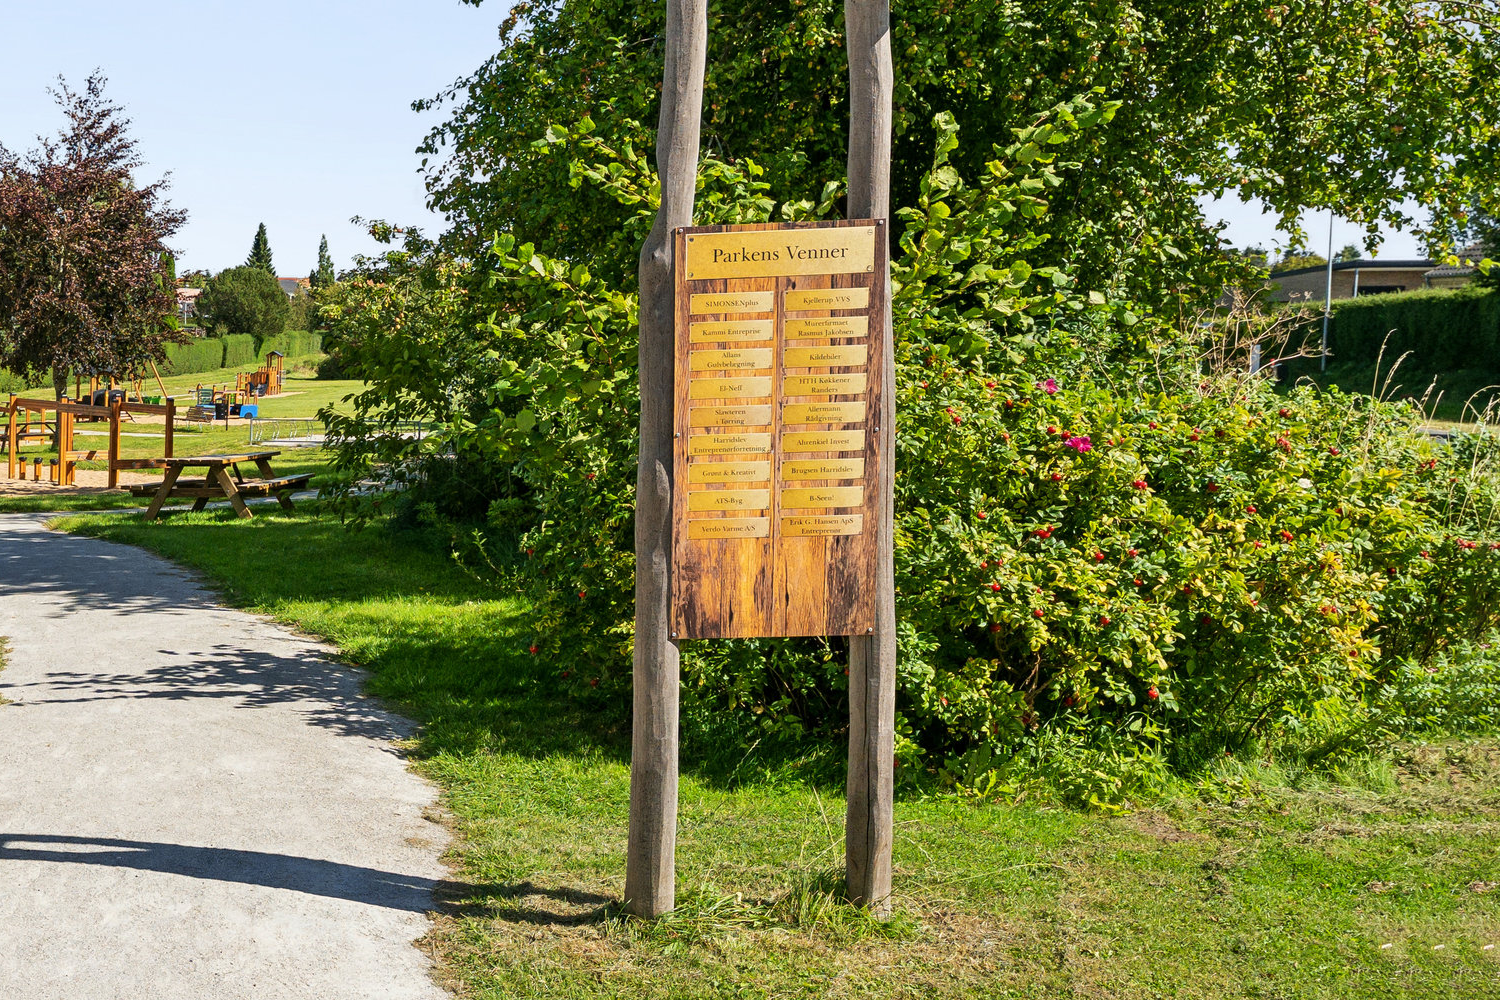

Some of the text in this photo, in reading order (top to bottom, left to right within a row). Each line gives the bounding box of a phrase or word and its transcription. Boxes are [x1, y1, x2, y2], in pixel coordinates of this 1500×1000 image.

[713, 246, 848, 263] Parkens Venner
[706, 300, 759, 308] SIMONSENplus
[728, 328, 762, 336] Entreprise
[694, 446, 766, 454] Entreprenørforretning
